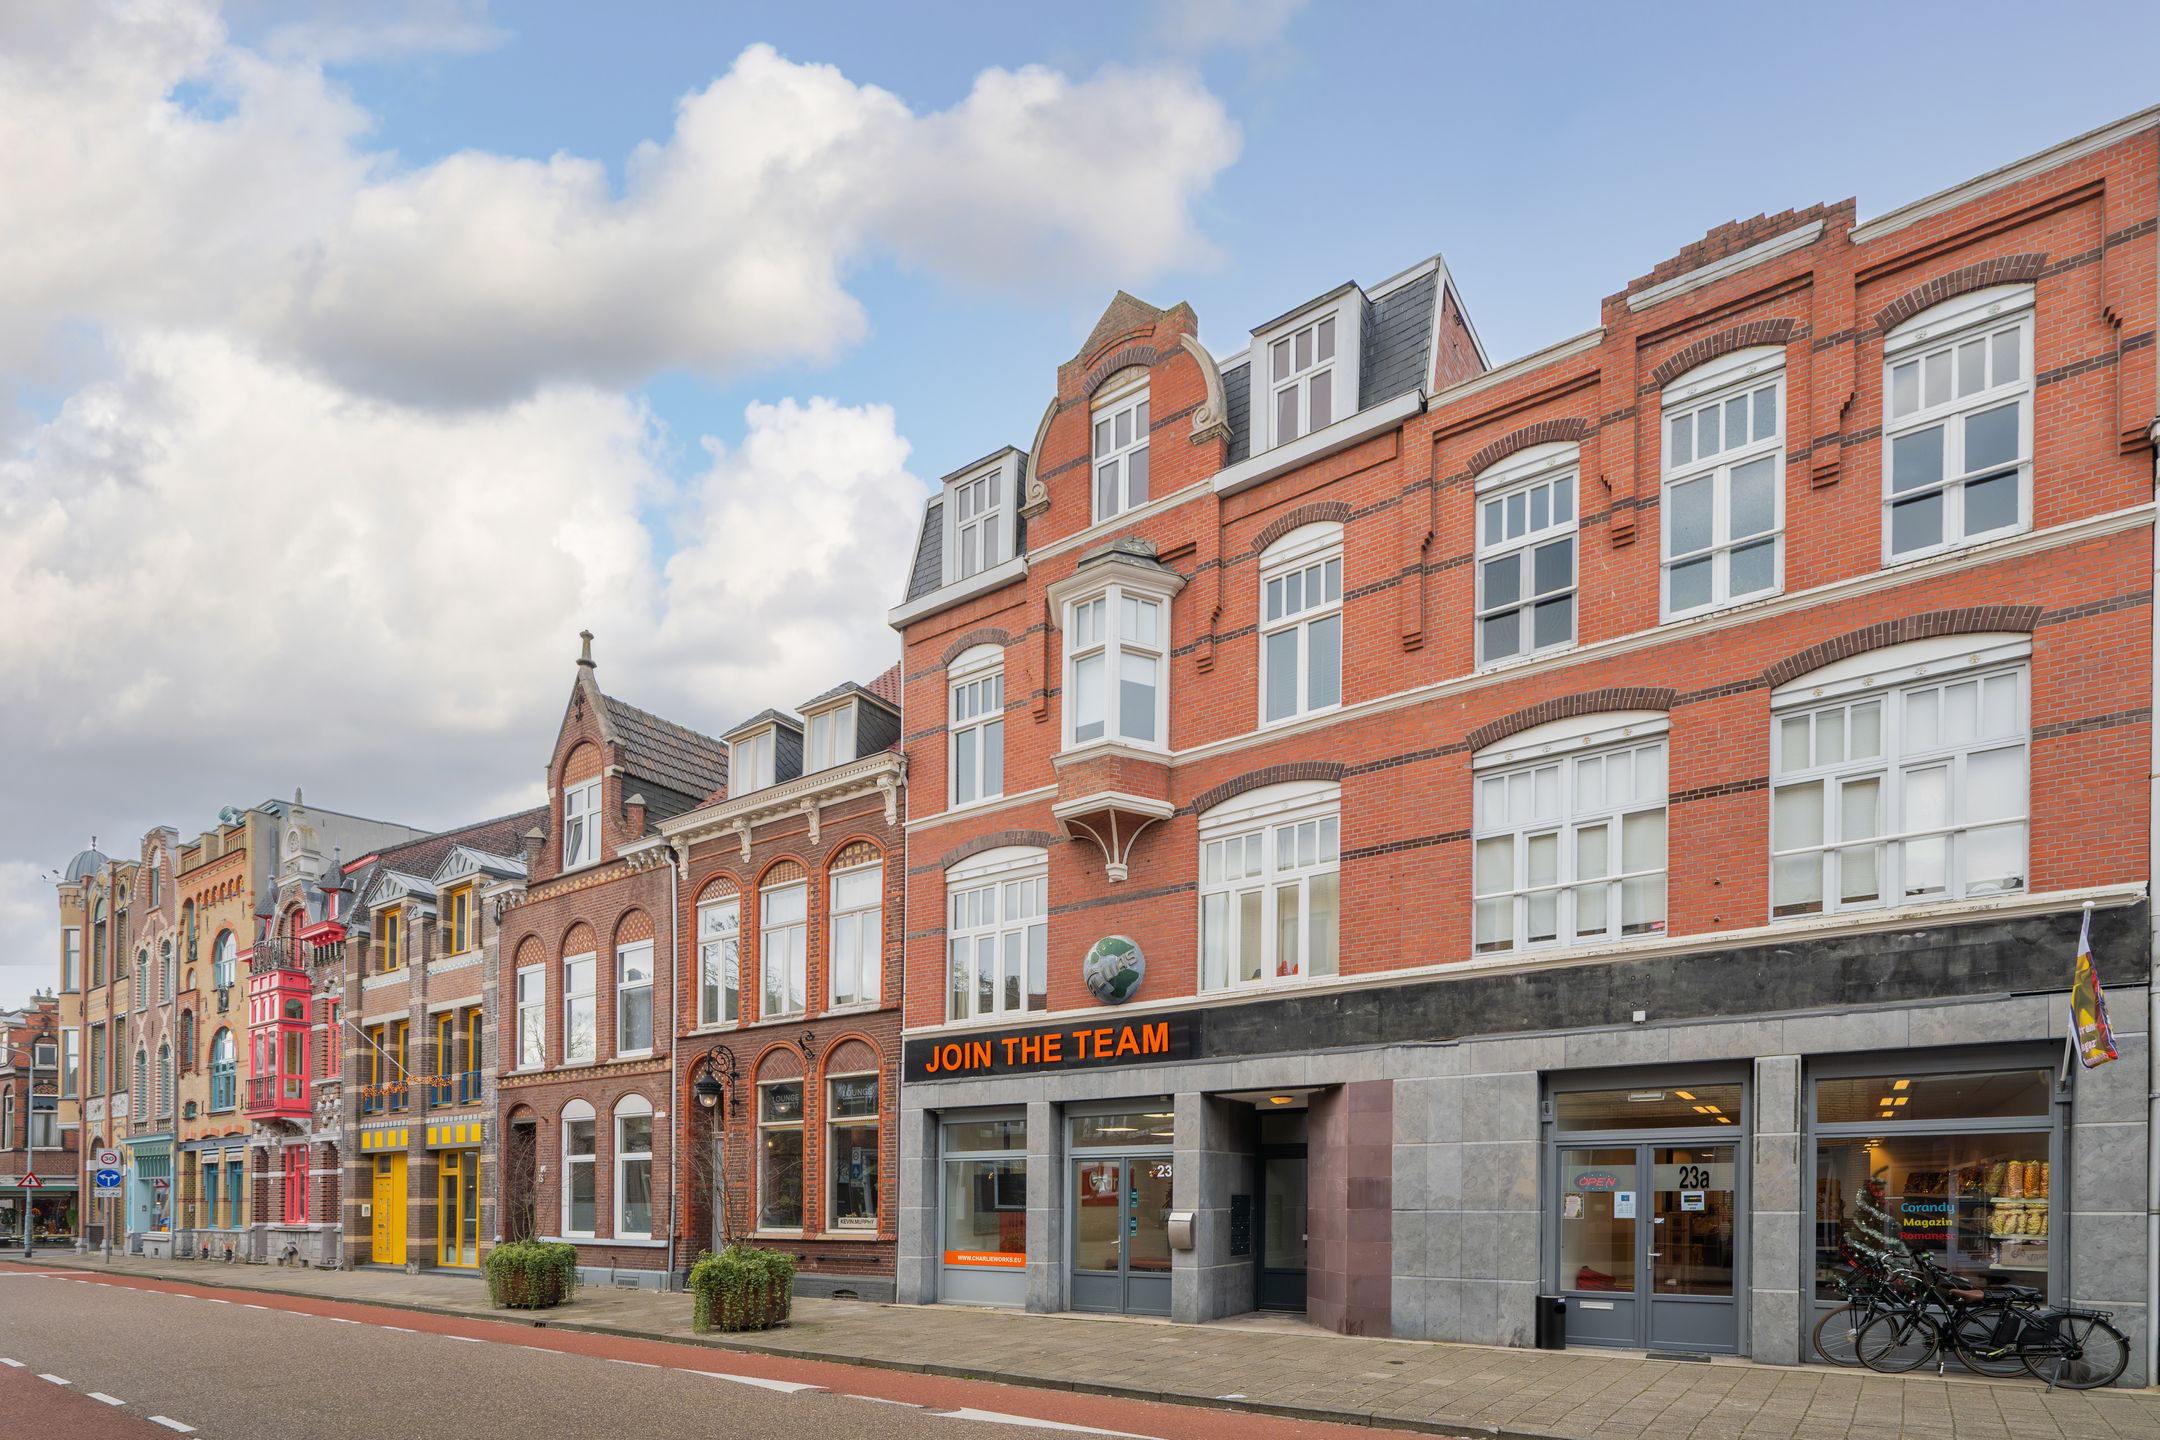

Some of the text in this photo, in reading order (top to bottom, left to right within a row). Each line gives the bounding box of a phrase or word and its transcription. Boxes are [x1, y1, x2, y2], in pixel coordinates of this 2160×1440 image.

[925, 1022, 1169, 1073] JOIN THE TEAM
[842, 1086, 873, 1097] LOUNGE
[772, 1093, 800, 1104] LOUNGE
[1157, 1164, 1172, 1178] 23
[1578, 1177, 1617, 1187] OPEN
[1679, 1166, 1710, 1189] 23a
[1900, 1202, 1955, 1215] Corandy
[1903, 1217, 1953, 1228] Magazin
[1900, 1231, 1957, 1240] Romanesc
[957, 1255, 1022, 1263] WWW.CHARLIEWORKS.EU
